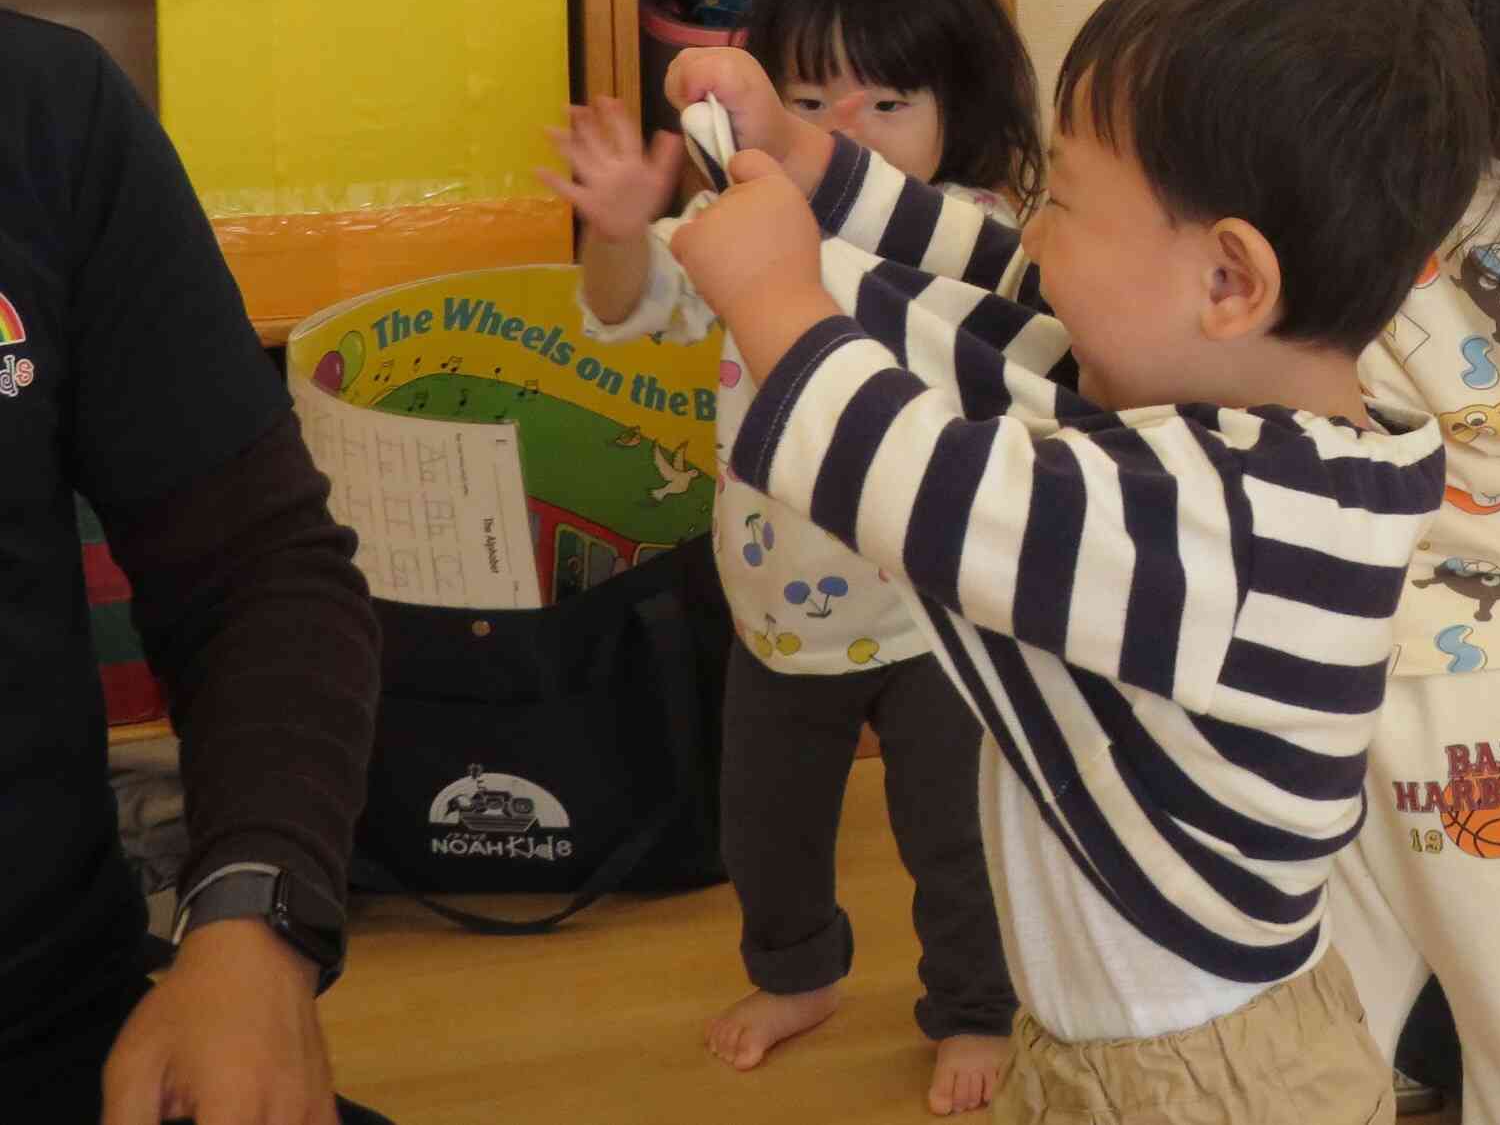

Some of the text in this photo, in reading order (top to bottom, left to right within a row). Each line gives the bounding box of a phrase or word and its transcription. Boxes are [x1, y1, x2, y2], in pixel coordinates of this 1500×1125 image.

[369, 306, 433, 351] The
[442, 297, 575, 366] Wheels
[574, 356, 626, 396] on
[628, 376, 689, 418] the
[431, 837, 503, 857] NOAH
